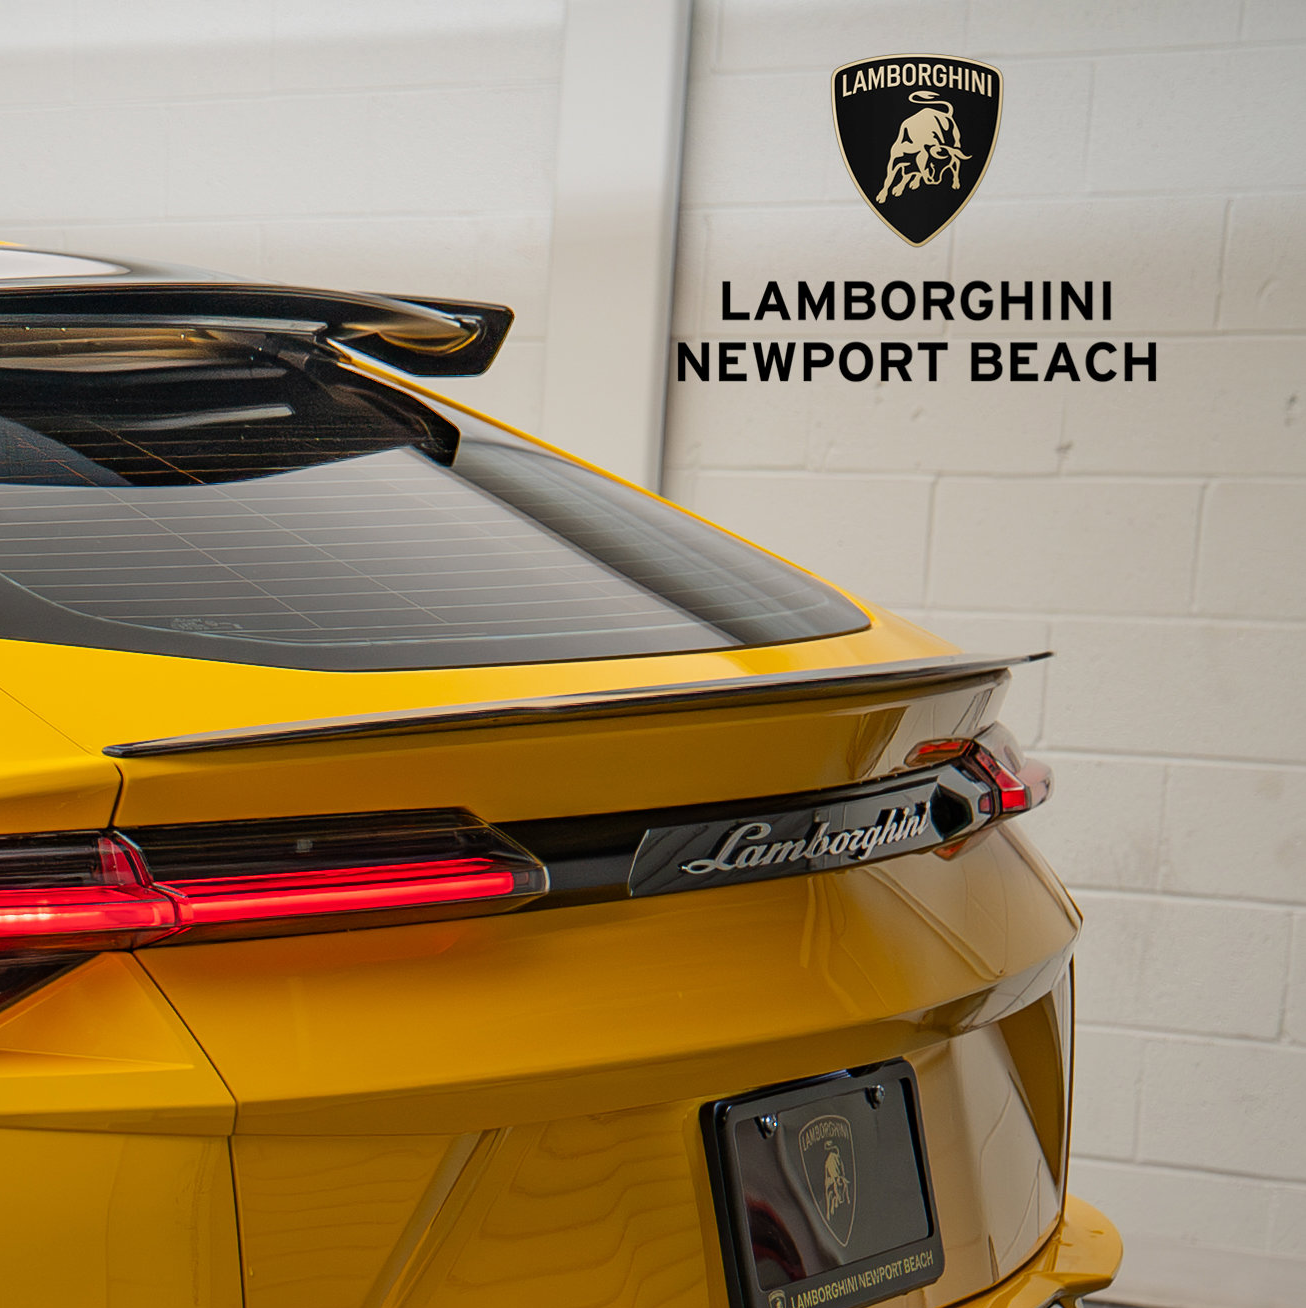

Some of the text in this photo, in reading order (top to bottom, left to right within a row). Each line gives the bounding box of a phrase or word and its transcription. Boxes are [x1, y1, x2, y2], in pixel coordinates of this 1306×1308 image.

[677, 799, 932, 875] Lamborghini
[858, 1261, 905, 1288] NEWPORT
[903, 1250, 934, 1273] BEACH
